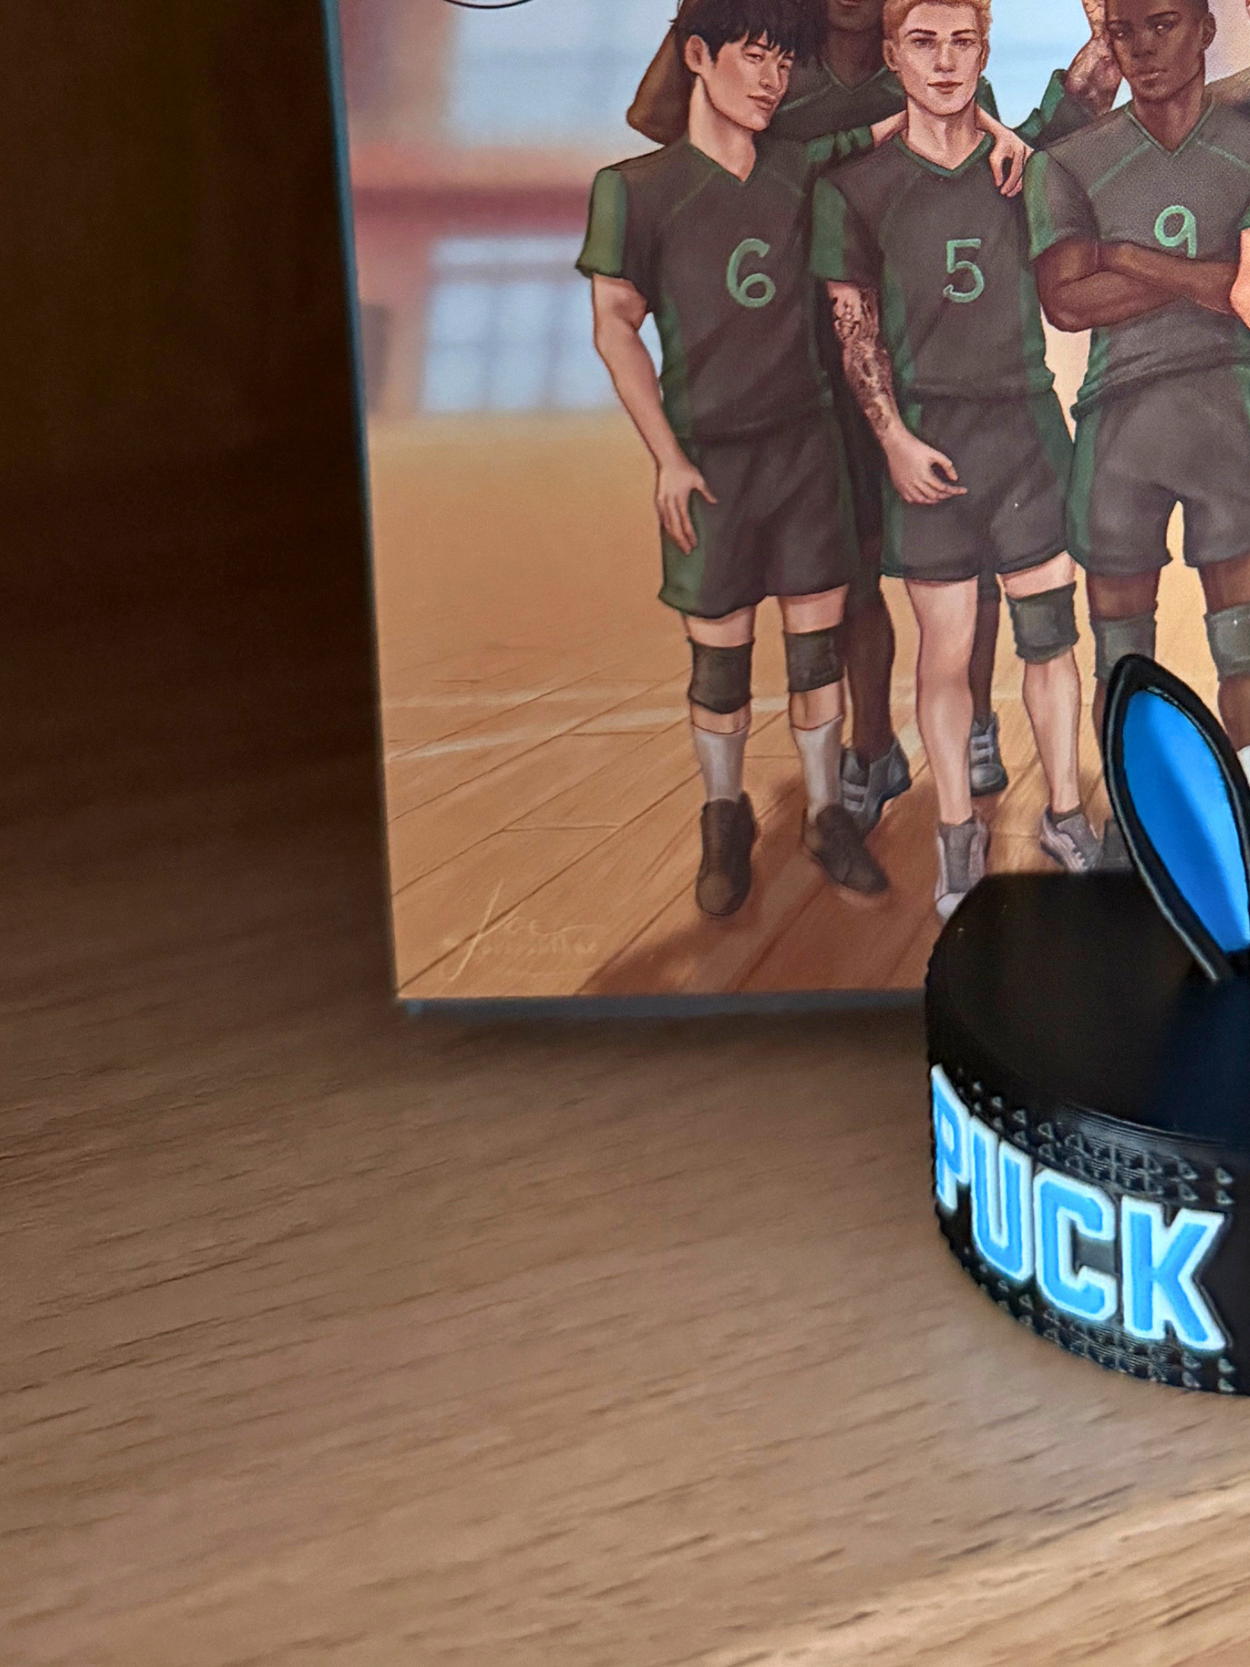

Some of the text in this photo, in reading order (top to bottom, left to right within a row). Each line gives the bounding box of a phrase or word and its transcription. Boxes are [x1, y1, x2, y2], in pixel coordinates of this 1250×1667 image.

[1153, 204, 1197, 259] 9
[724, 237, 777, 309] 6
[941, 237, 985, 304] 5
[930, 1062, 1229, 1353] PUCK
